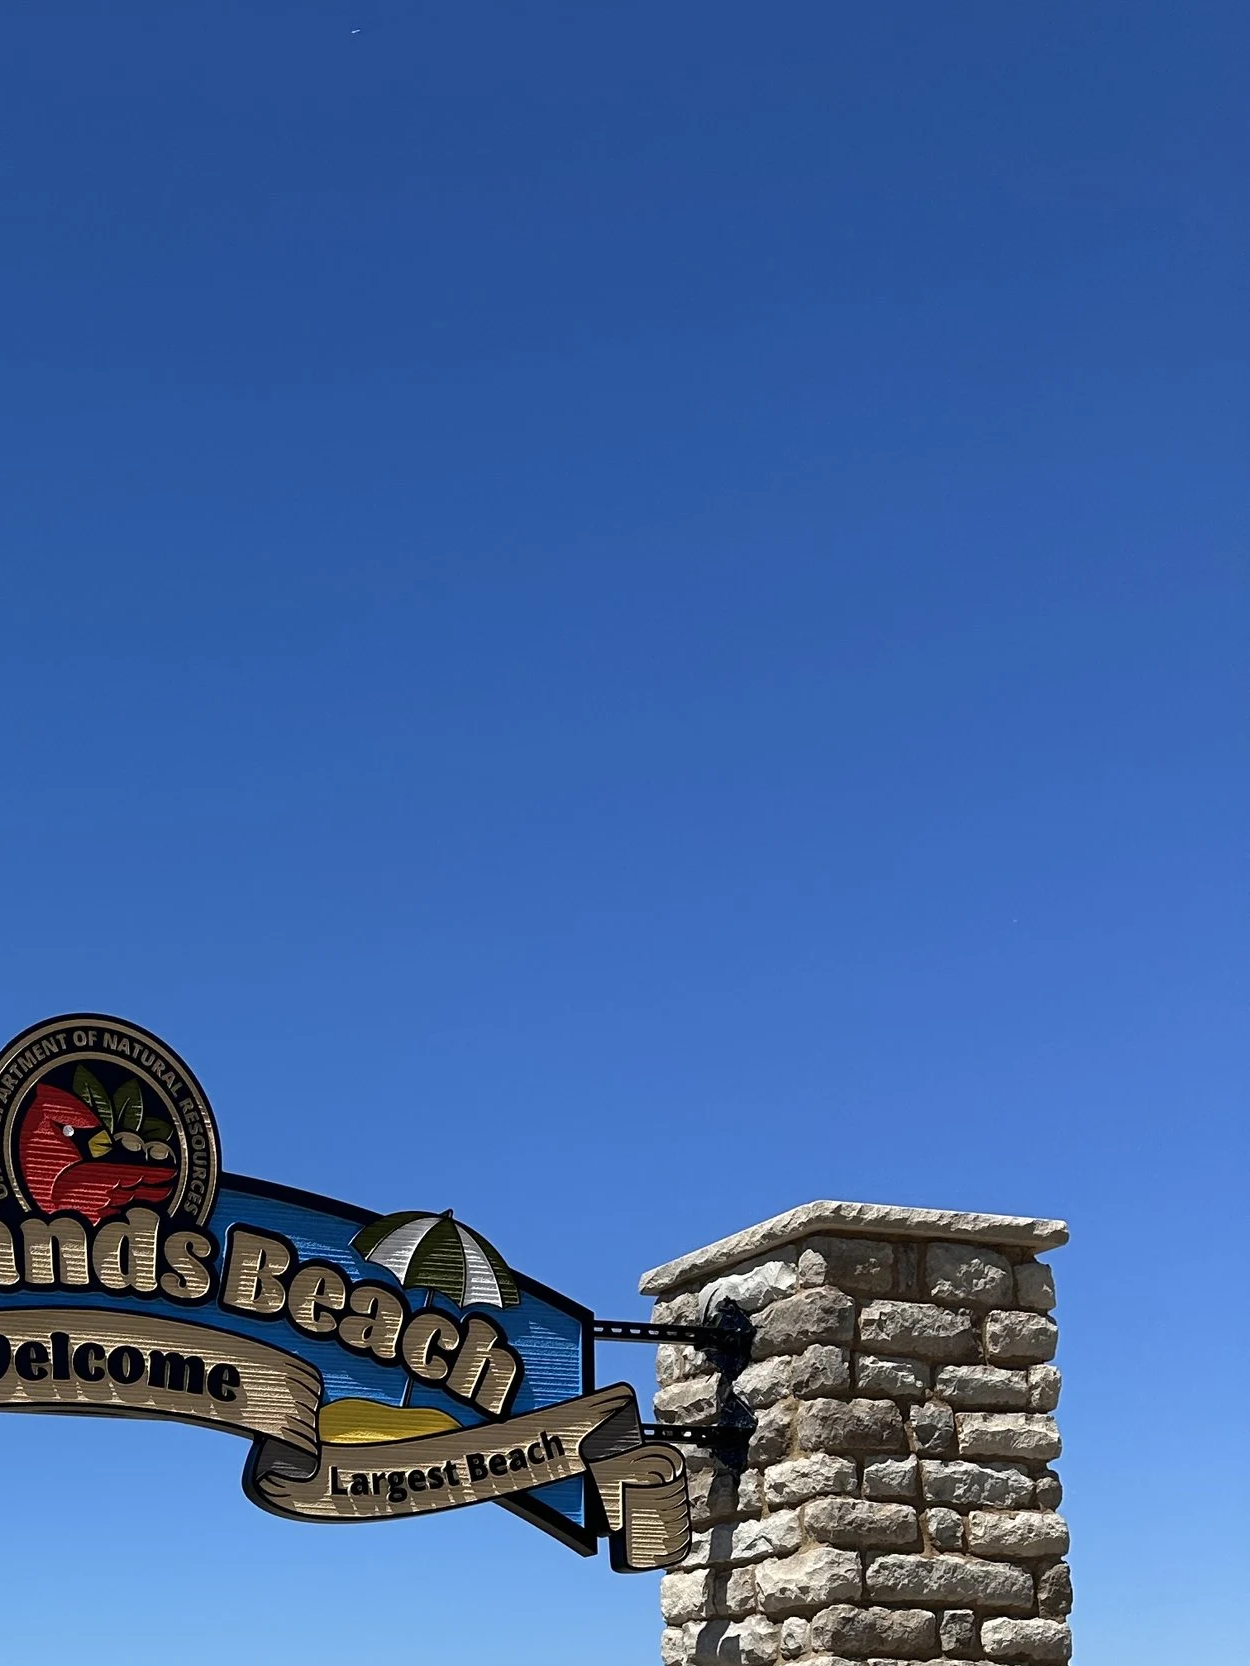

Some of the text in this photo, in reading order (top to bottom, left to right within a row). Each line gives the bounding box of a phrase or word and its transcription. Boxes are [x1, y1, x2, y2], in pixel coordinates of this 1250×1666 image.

[72, 1030, 98, 1047] OF
[103, 1032, 185, 1099] NATURAL
[178, 1096, 207, 1216] RESOURCES
[224, 1228, 517, 1417] Beach
[330, 1431, 566, 1504] Largest Beach
